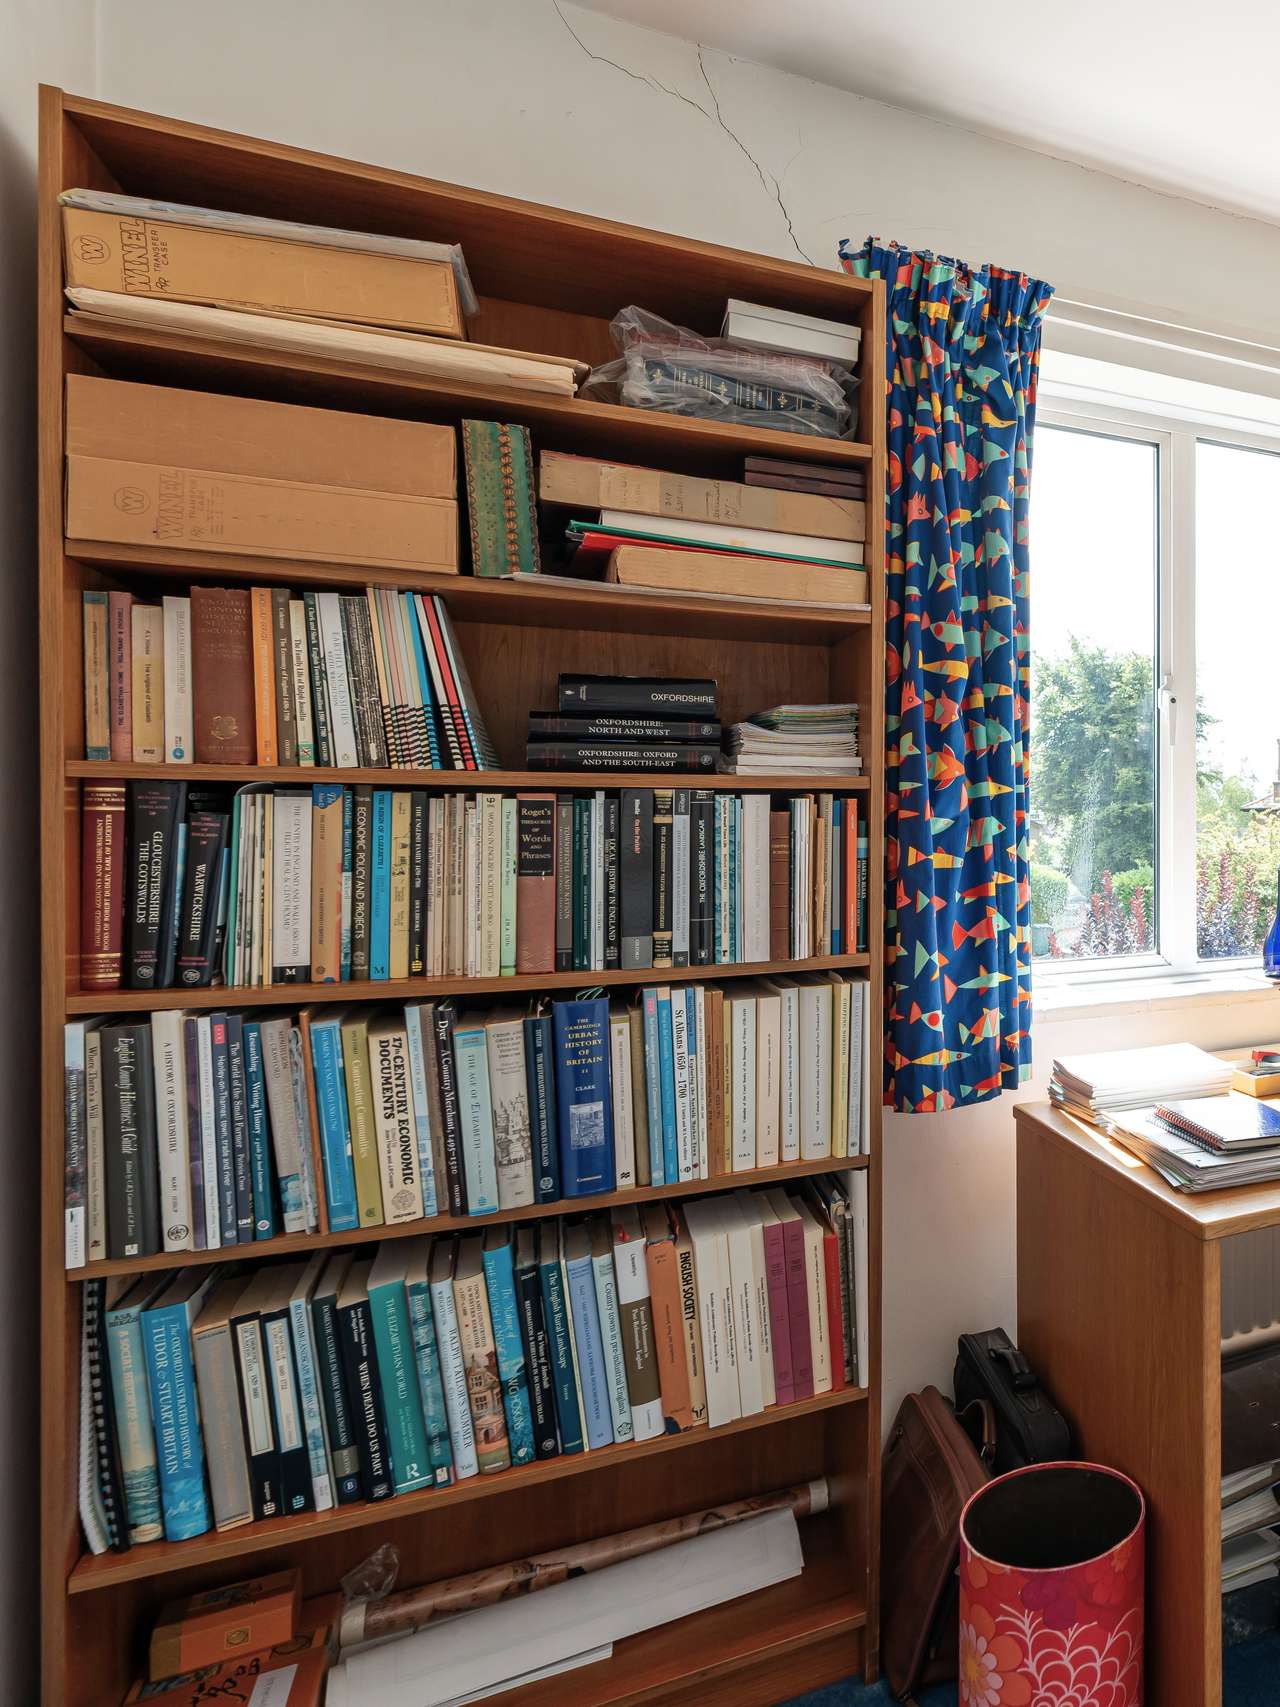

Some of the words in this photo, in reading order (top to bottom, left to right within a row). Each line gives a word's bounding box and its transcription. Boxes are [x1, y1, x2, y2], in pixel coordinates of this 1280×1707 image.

[119, 218, 152, 293] WINEL
[151, 229, 161, 272] TRANSFER
[161, 241, 170, 266] CASE
[332, 632, 344, 669] EARTHLY
[337, 673, 349, 726] NECESSITIES
[651, 693, 715, 704] OXFORDSHIRE
[589, 727, 621, 735] NORTH
[623, 728, 642, 736] AND
[644, 728, 671, 737] WEST
[596, 718, 664, 728] OXFORDSHIRE:
[578, 750, 642, 759] OXFORDSHIRE:
[644, 751, 678, 760] OXFORD
[582, 759, 600, 767] AND
[602, 759, 621, 767] THE
[623, 760, 677, 768] SOUTH-EAST
[521, 808, 552, 817] Roget's
[356, 807, 367, 850] ECONOMIC
[522, 835, 552, 843] Words
[139, 841, 149, 862] THE
[522, 852, 552, 860] Phrases
[609, 839, 617, 862] LOCAL
[149, 831, 163, 924] GLOUCESTERSHIRE
[356, 853, 366, 880] POLICY
[356, 881, 366, 899] AND
[609, 866, 617, 894] HISTORY
[136, 864, 149, 924] COTSWOLDS
[190, 864, 206, 941] WARWICKSHIRE
[609, 897, 617, 905] IN
[355, 903, 365, 939] PROJECTS
[609, 907, 617, 941] ENGLAND
[675, 1009, 684, 1019] St
[437, 1021, 449, 1041] Dyer
[565, 1023, 601, 1031] CAMBRIDGE
[568, 1031, 599, 1039] URBAN
[676, 1021, 685, 1049] Albans
[114, 1038, 135, 1063] English
[231, 1043, 240, 1055] The
[249, 1032, 259, 1072] Researching
[565, 1039, 602, 1049] HISTORY
[88, 1046, 98, 1069] Where
[164, 1051, 174, 1083] HISTORY
[231, 1057, 241, 1078] World
[468, 1054, 477, 1069] THE
[566, 1056, 603, 1066] BRITAIN
[677, 1052, 686, 1070] 1650
[89, 1072, 99, 1097] There's
[115, 1065, 134, 1089] County
[217, 1056, 229, 1118] Henley-on-Thames:
[351, 1059, 363, 1104] Contrasting
[380, 1040, 395, 1120] DOCUMENTS
[394, 1056, 407, 1115] CENTURY
[439, 1058, 453, 1091] Country
[469, 1072, 478, 1087] AGE
[166, 1086, 175, 1096] OF
[233, 1088, 242, 1099] the
[251, 1082, 261, 1108] Writing
[471, 1090, 478, 1099] OF
[576, 1084, 596, 1092] CLARK
[678, 1080, 687, 1099] 1700
[90, 1104, 99, 1119] Will
[120, 1091, 137, 1124] Histories:
[234, 1100, 243, 1121] Small
[444, 1093, 455, 1134] Merchant,
[167, 1099, 177, 1154] OXFORDSHIRE
[220, 1120, 229, 1138] town,
[253, 1110, 263, 1135] History
[356, 1107, 369, 1159] Communities
[471, 1103, 482, 1150] ELIZABETH
[122, 1134, 138, 1154] Guide
[222, 1140, 230, 1156] trade
[234, 1123, 244, 1148] Farmer
[222, 1158, 231, 1169] and
[399, 1119, 415, 1185] ECONOMIC
[548, 1272, 558, 1286] The
[680, 1252, 694, 1286] ENGLISH
[384, 1298, 396, 1314] THE
[549, 1287, 560, 1313] English
[604, 1282, 615, 1311] Country
[682, 1288, 696, 1321] SOCIETY
[109, 1318, 139, 1328] BRIGGS
[115, 1312, 132, 1322] ASA
[169, 1323, 181, 1336] The
[322, 1305, 331, 1334] DOMESTIC
[553, 1314, 562, 1333] Rural
[608, 1313, 616, 1332] towns
[632, 1309, 642, 1349] Post-Reformation
[152, 1327, 169, 1369] TUDOR
[326, 1336, 336, 1363] CULTURE
[387, 1316, 402, 1366] ELIZABETHAN
[448, 1328, 459, 1361] RALPH
[555, 1334, 567, 1369] Landscape
[171, 1337, 184, 1371] OXFORD
[609, 1341, 623, 1386] pre-industrial
[635, 1351, 643, 1370] England
[330, 1371, 339, 1390] EARLY
[359, 1362, 371, 1391] WHEN
[395, 1369, 407, 1400] WORLD
[453, 1364, 466, 1406] TAILOR'S
[507, 1377, 520, 1394] WG
[158, 1382, 176, 1426] STUART
[174, 1371, 189, 1424] ILLUSTRATED
[333, 1391, 343, 1416] MODERN
[362, 1392, 375, 1422] DEATH
[615, 1387, 627, 1416] England
[512, 1396, 522, 1431] HOSKINS
[337, 1417, 348, 1445] ENGLAND
[367, 1425, 377, 1438] DO
[458, 1408, 473, 1449] SUMMER
[162, 1429, 178, 1475] BRITAIN
[179, 1426, 192, 1460] HISTORY
[369, 1439, 378, 1450] US
[370, 1453, 383, 1476] PART
